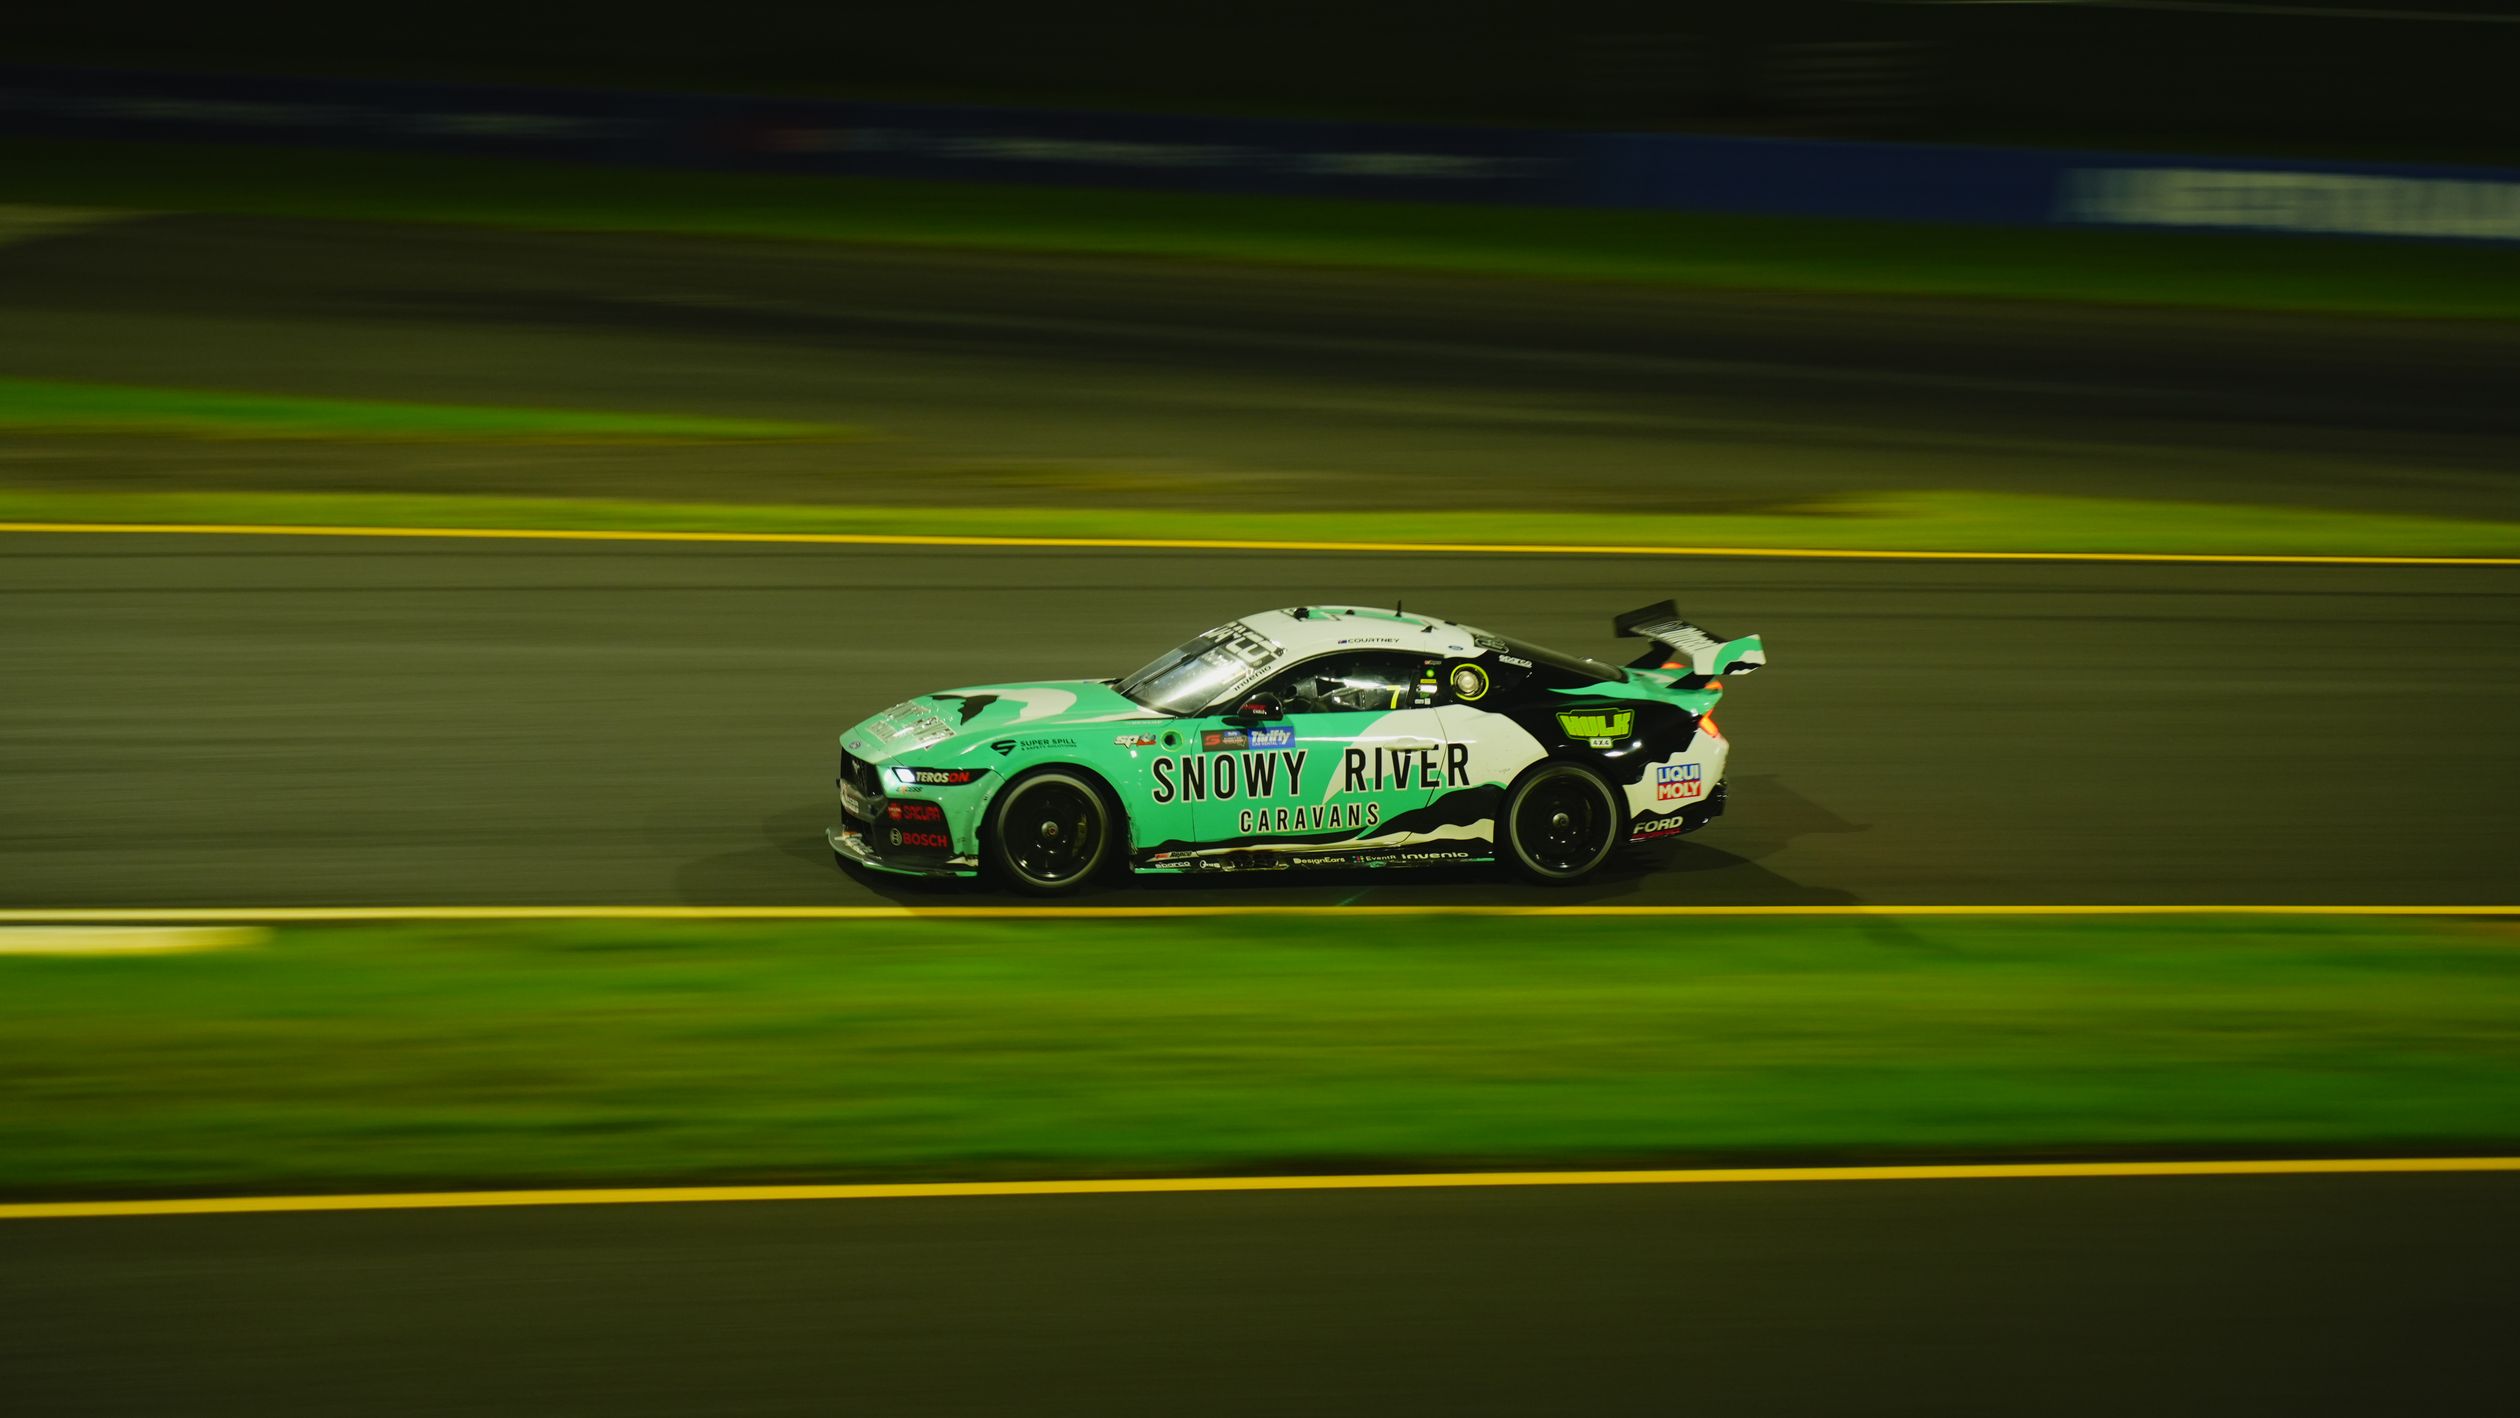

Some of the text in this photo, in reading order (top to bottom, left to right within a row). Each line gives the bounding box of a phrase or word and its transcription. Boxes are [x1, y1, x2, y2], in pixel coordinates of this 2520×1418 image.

[1386, 684, 1401, 709] 7
[1560, 712, 1631, 737] HULK
[1251, 729, 1292, 745] Thrifty
[916, 771, 970, 783] TEROSON
[1152, 742, 1472, 805] SNOWY RIVER
[1658, 764, 1701, 783] LIQUI
[1658, 781, 1701, 800] MOLY
[1239, 802, 1380, 834] CARAVANS
[1633, 816, 1684, 834] FORD
[903, 833, 947, 846] BOSCH
[1401, 852, 1469, 860] invenio
